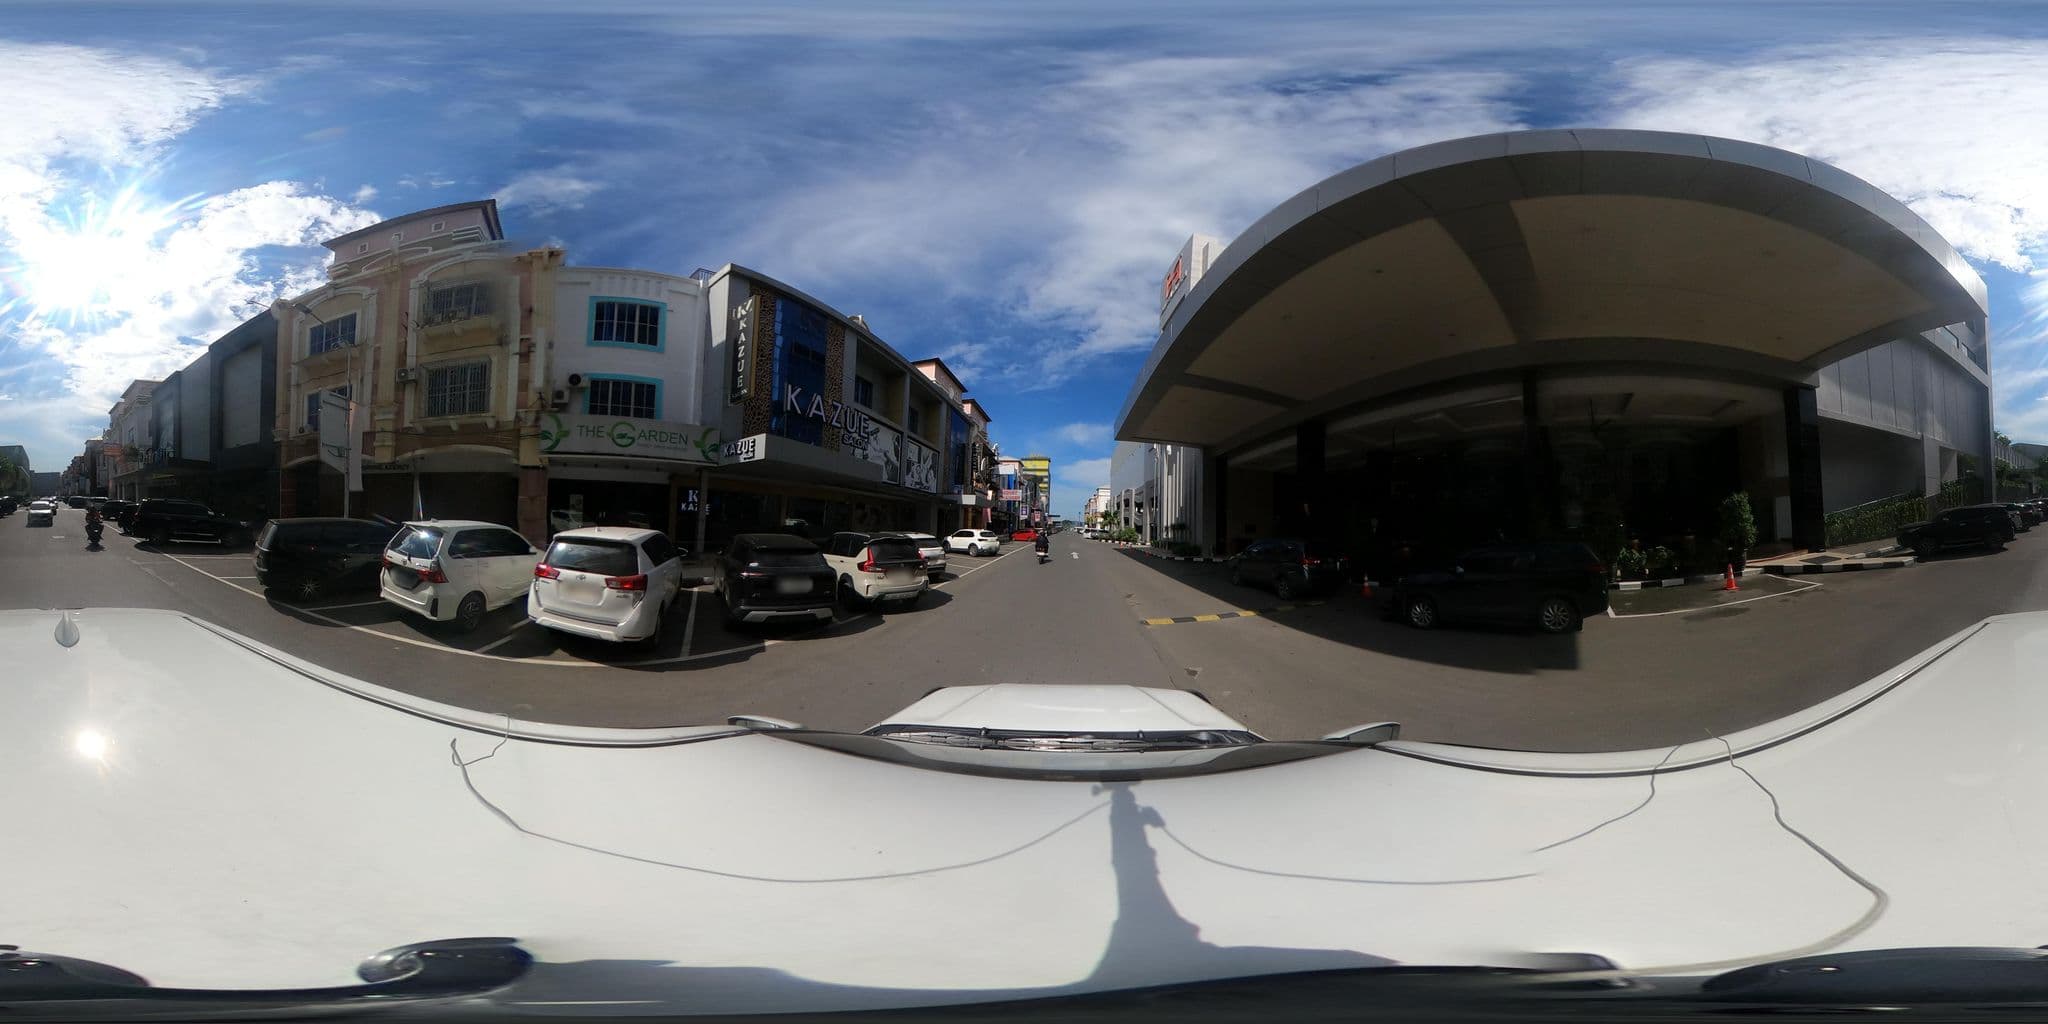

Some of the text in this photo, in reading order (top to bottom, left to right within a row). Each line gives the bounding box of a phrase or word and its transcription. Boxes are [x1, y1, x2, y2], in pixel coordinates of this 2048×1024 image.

[738, 318, 747, 388] KAZUE
[787, 383, 870, 438] KAZUE
[577, 421, 689, 447] THE GARDEN
[724, 438, 755, 457] KAZUE
[681, 502, 711, 512] KAE
